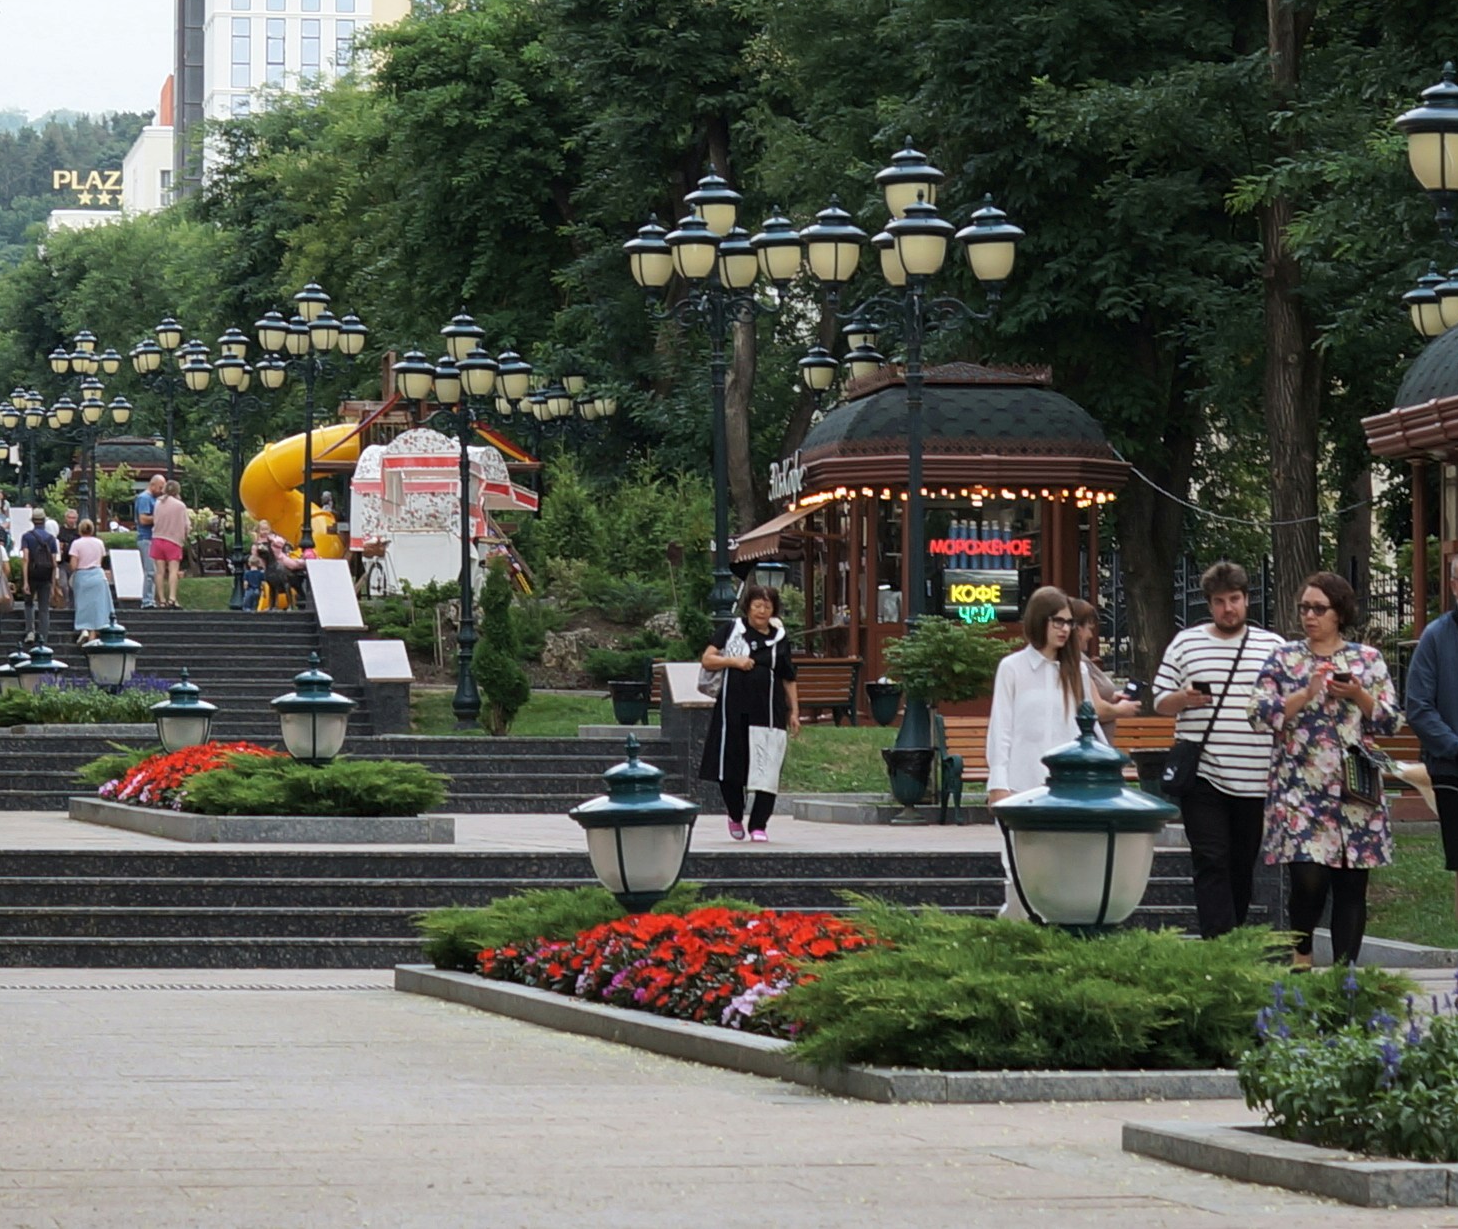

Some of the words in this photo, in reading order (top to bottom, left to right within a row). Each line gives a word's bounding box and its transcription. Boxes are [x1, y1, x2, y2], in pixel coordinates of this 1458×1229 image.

[53, 170, 124, 189] PLAZ
[930, 539, 1032, 556] МОРОЖЕНОЕ
[951, 584, 1001, 603] КОФЕ
[959, 603, 995, 624] ЧАЙ
